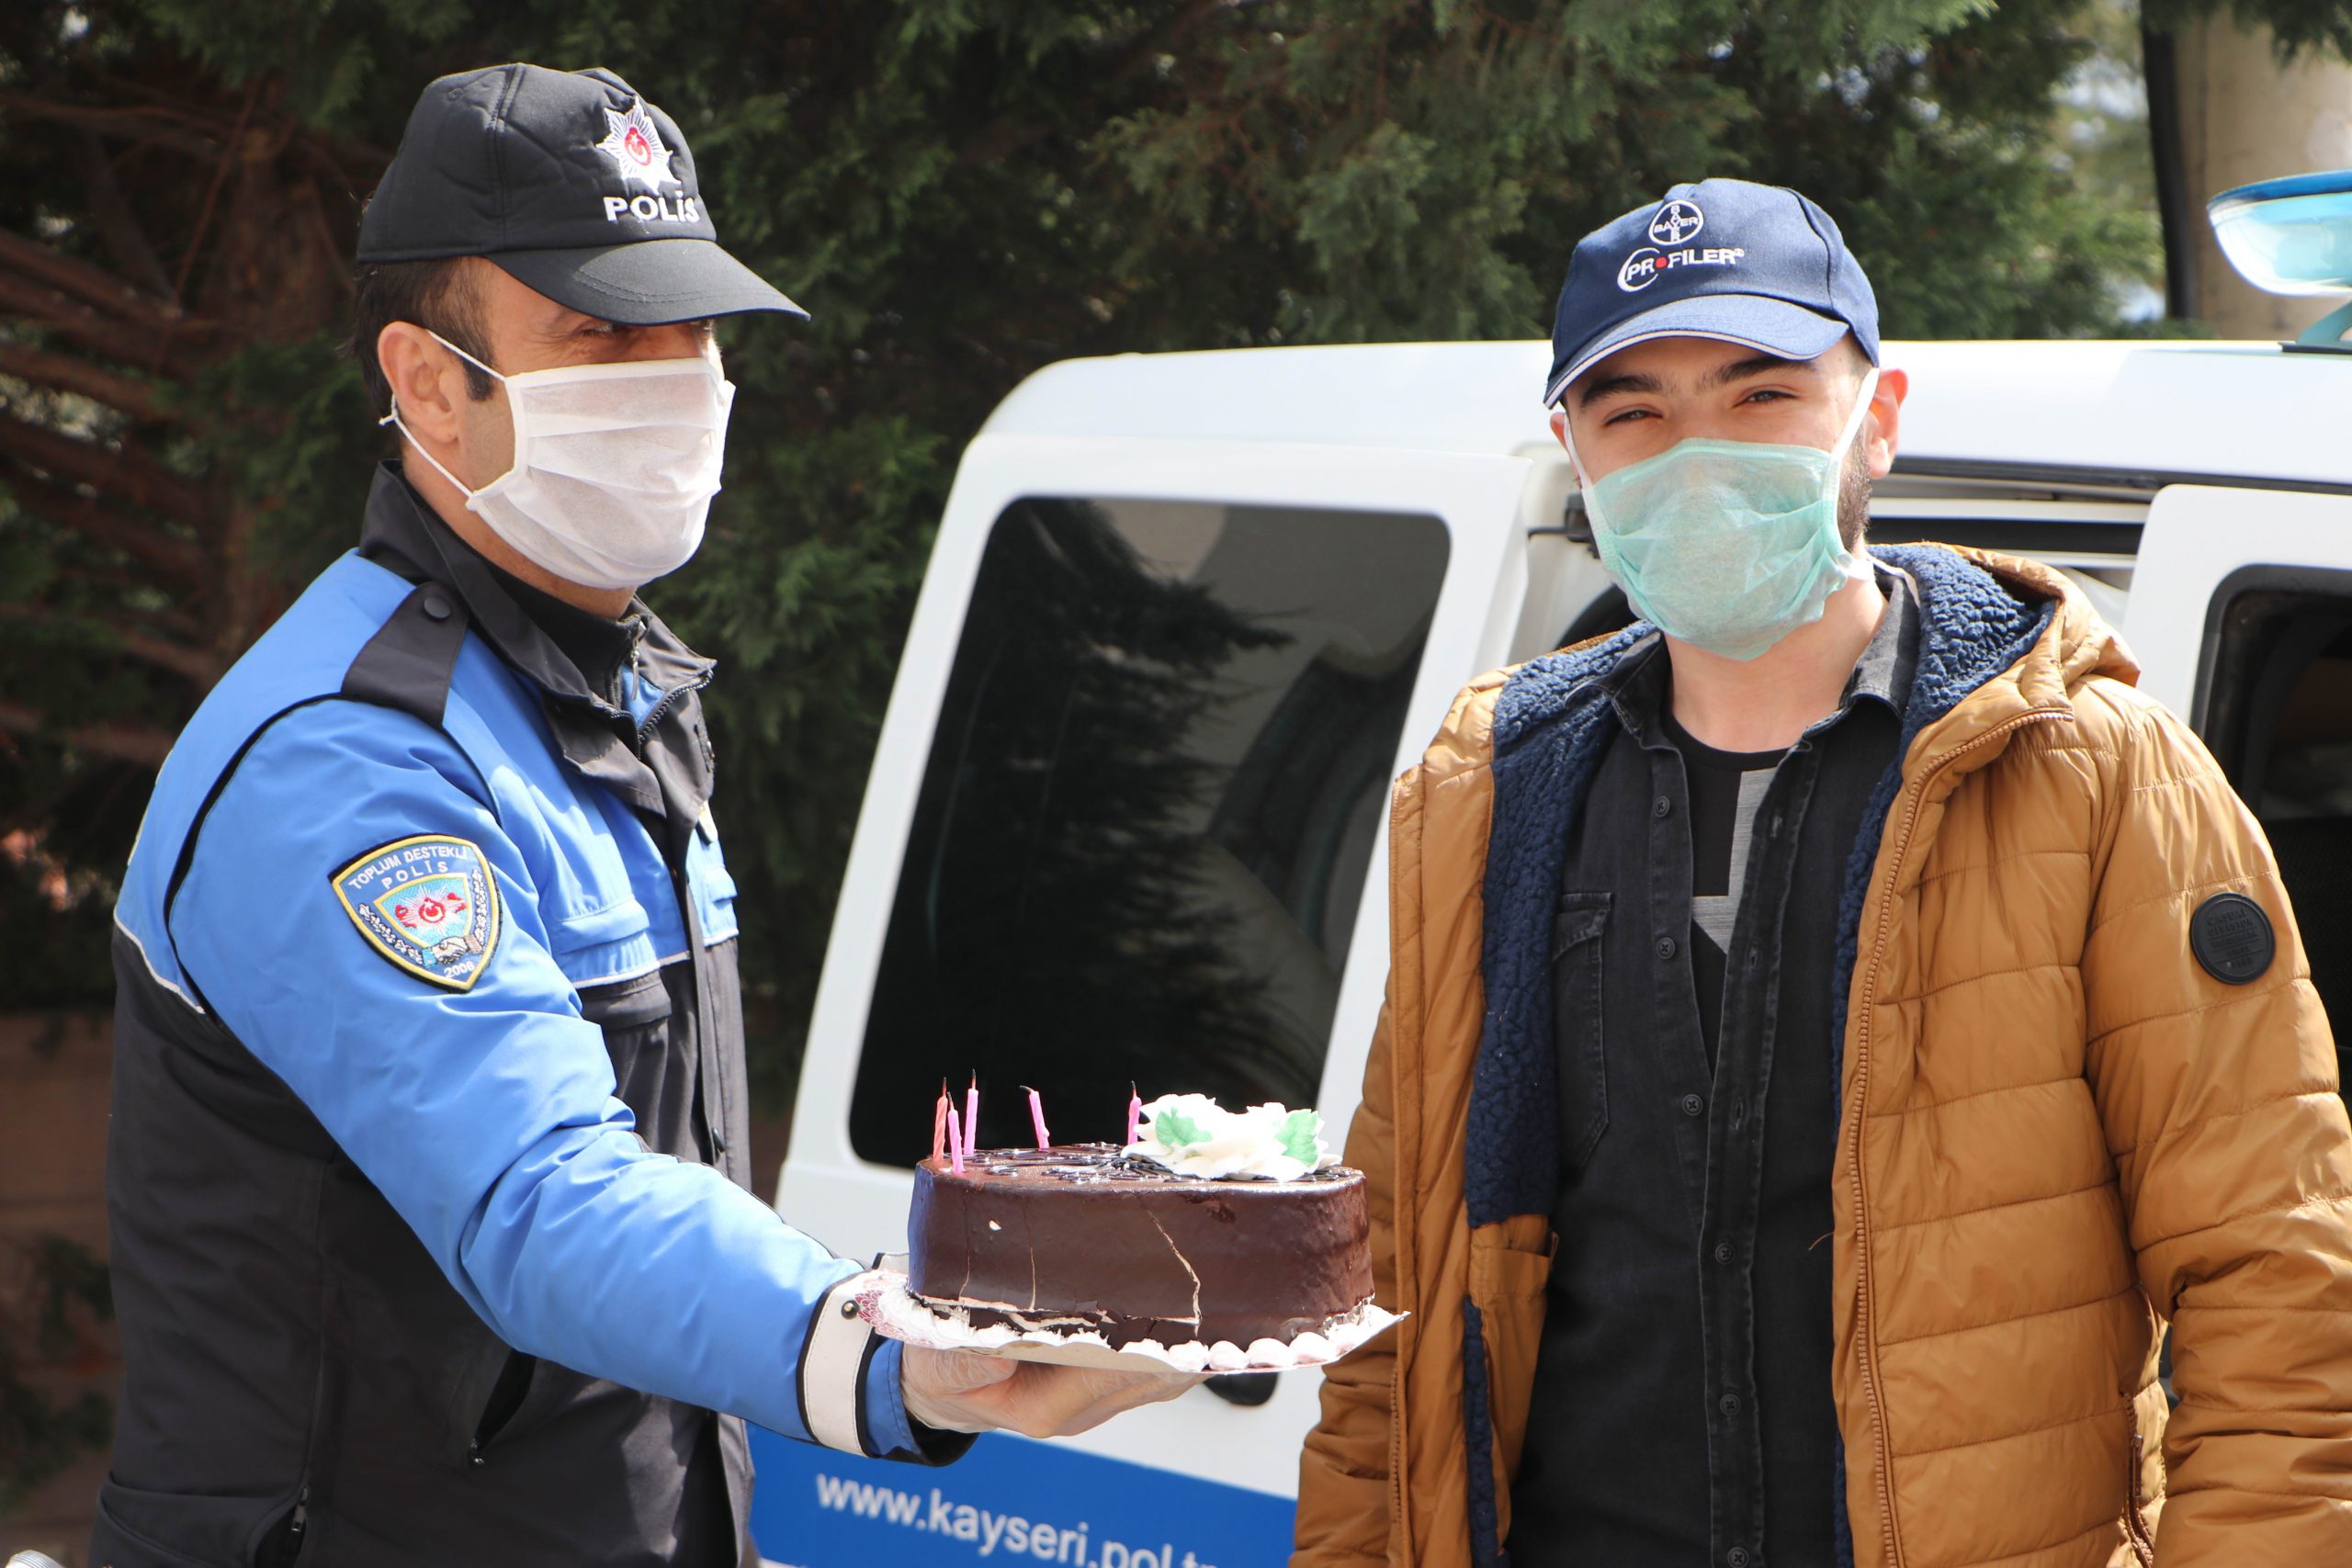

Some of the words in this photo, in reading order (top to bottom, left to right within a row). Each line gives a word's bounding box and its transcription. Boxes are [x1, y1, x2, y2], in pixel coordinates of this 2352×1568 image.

[1654, 216, 1698, 233] BAYER
[348, 854, 401, 889] TOPLUM
[444, 961, 475, 977] 2006
[816, 1473, 1218, 1568] www.kayseri.pol
